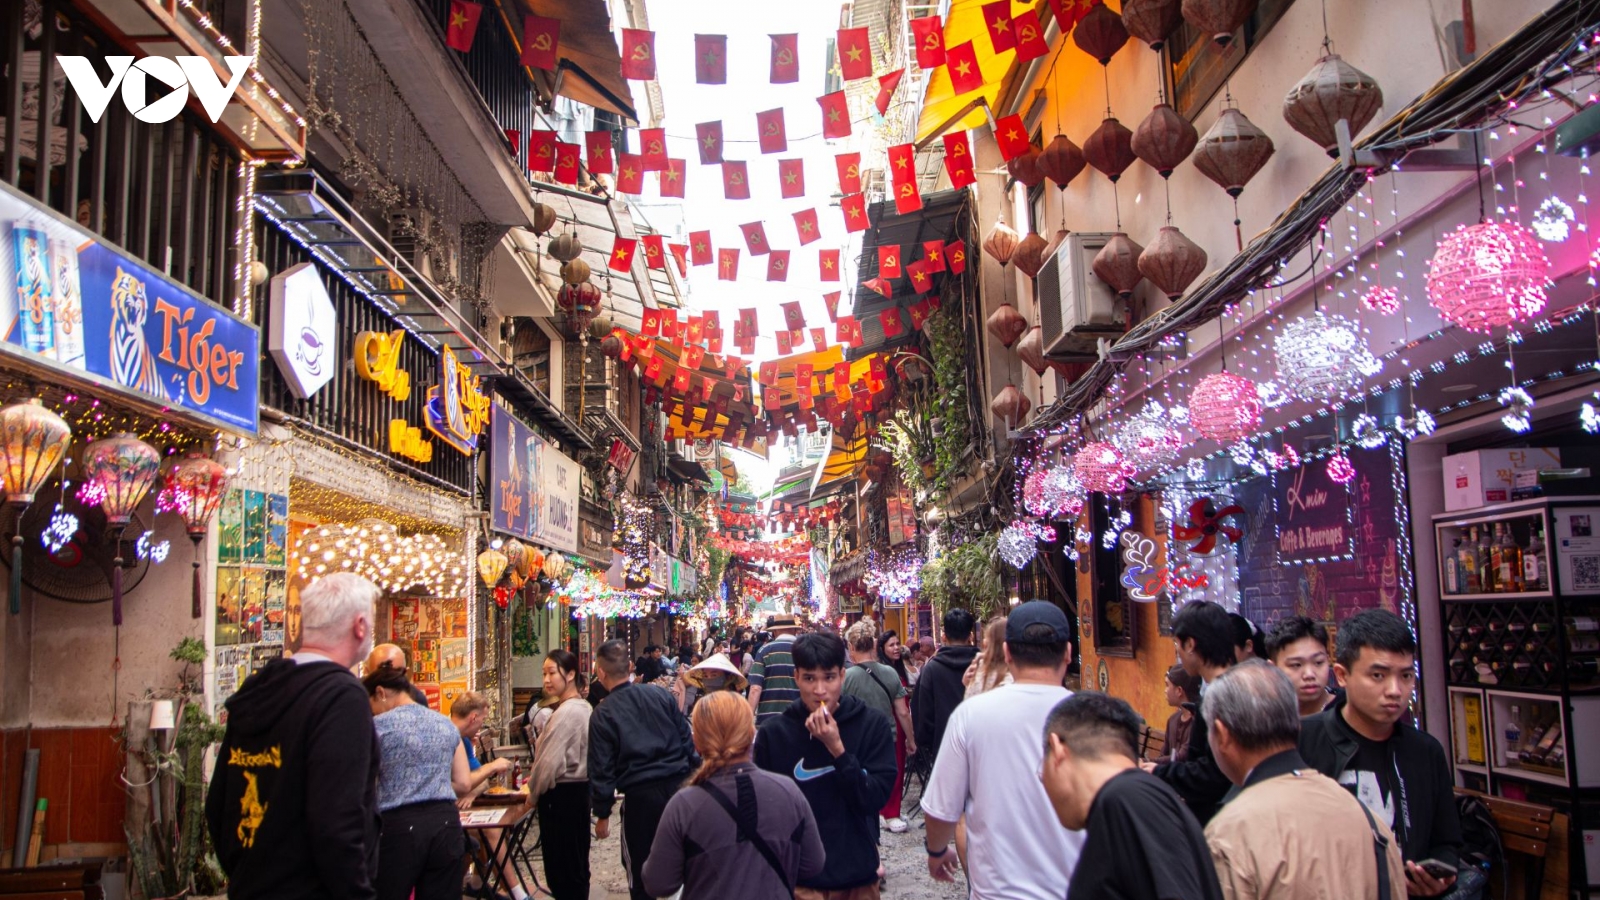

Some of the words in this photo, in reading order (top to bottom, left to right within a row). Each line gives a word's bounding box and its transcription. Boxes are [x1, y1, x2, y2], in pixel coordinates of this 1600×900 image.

[154, 296, 245, 405] Tiger
[457, 361, 491, 435] Tiger
[501, 479, 523, 530] Tiger
[1298, 527, 1305, 549] &
[1305, 525, 1344, 552] Beverages
